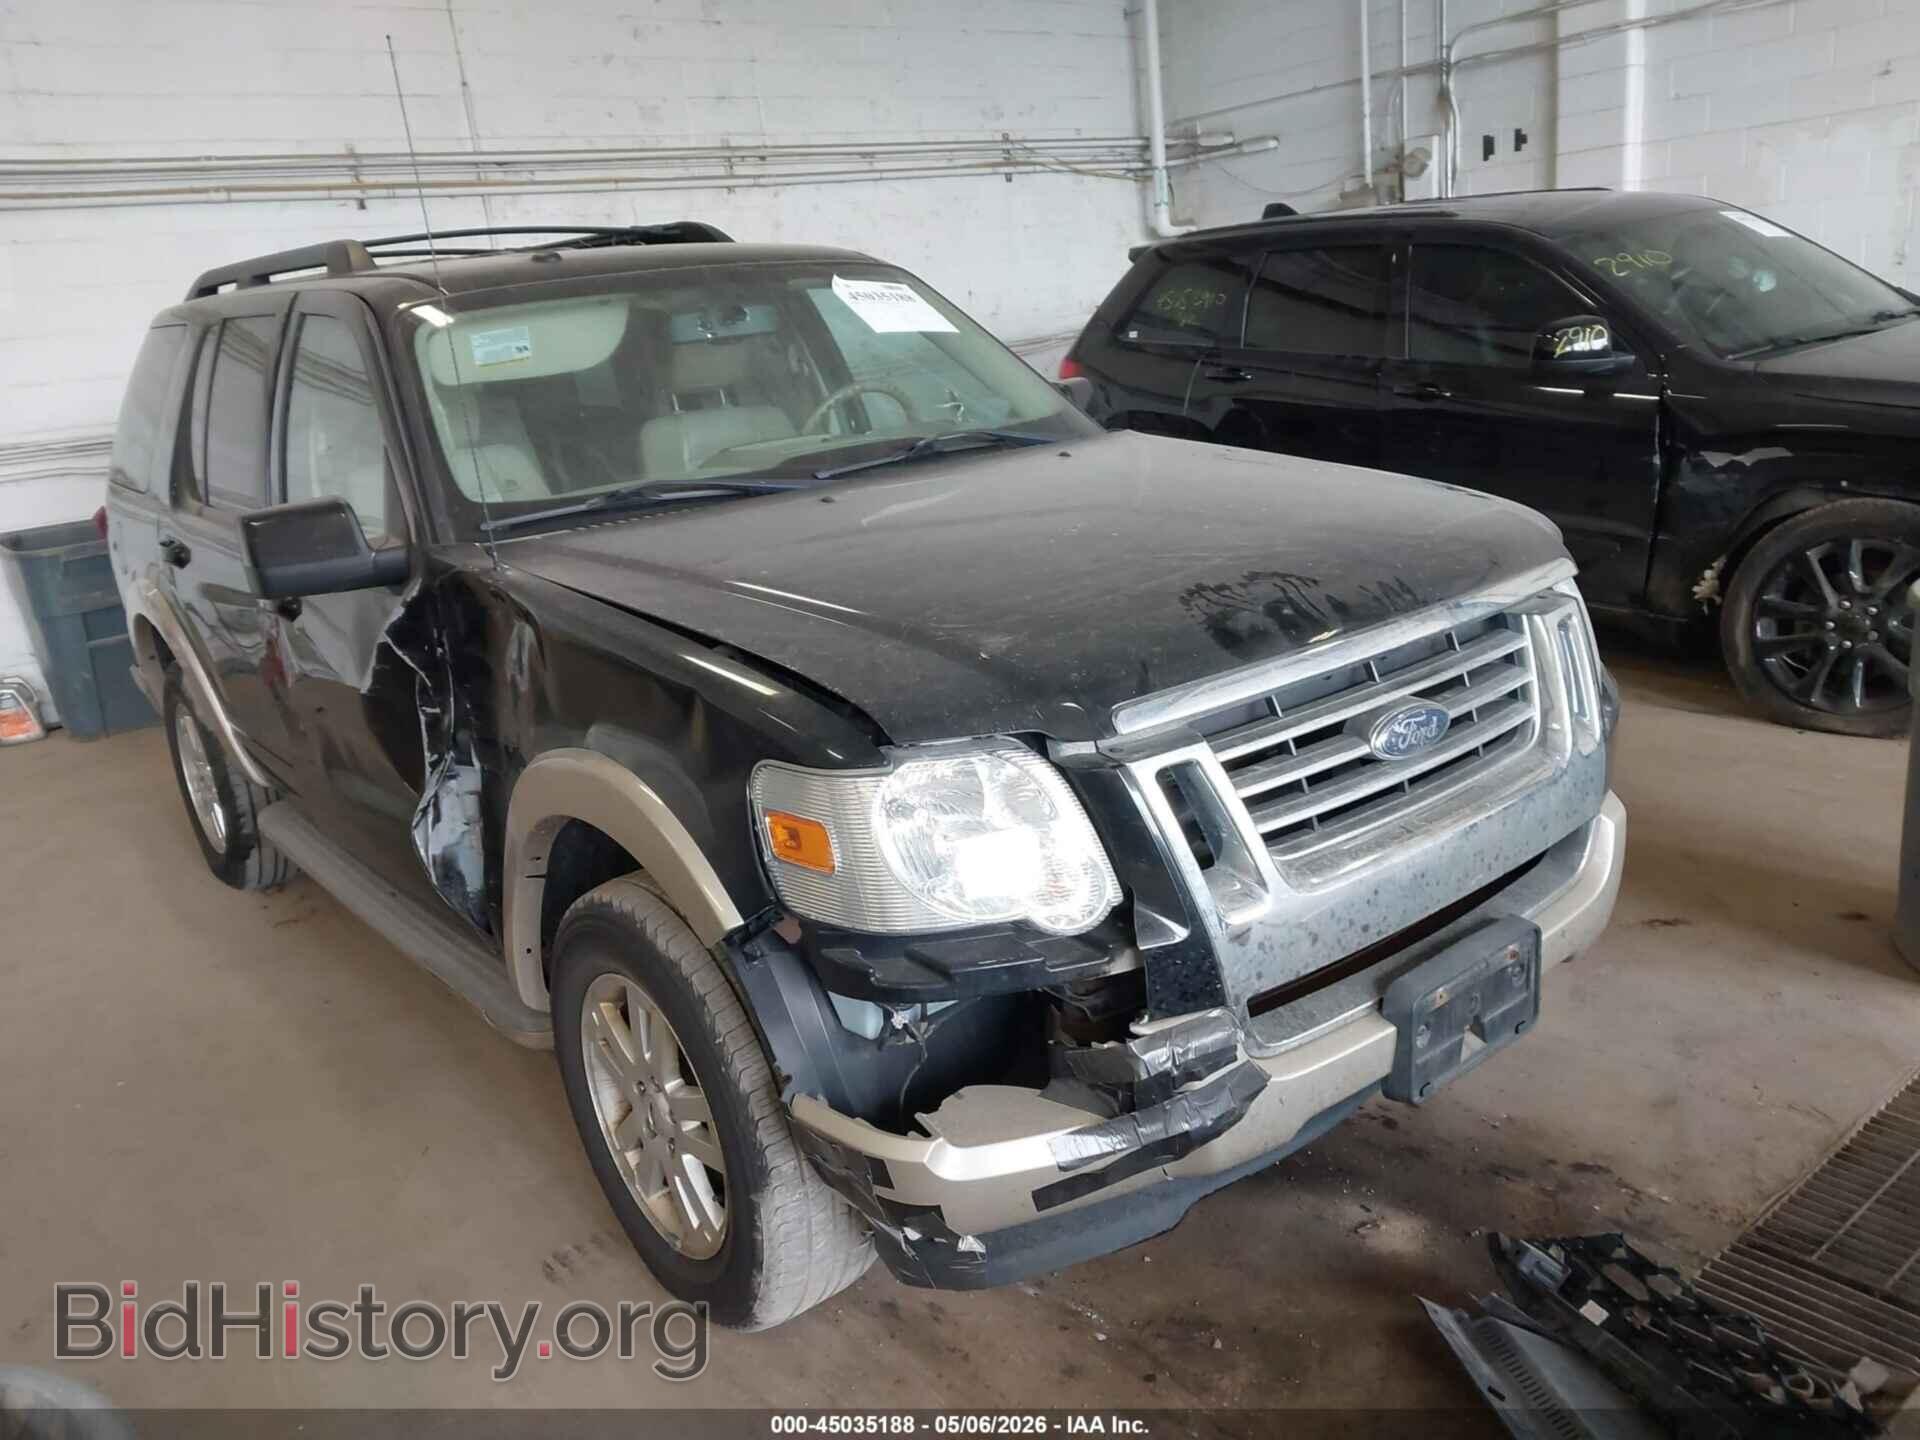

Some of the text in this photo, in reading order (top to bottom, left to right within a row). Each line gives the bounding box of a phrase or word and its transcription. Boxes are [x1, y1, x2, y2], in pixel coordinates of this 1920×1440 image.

[1593, 249, 1672, 277] 2910
[1553, 324, 1609, 358] 2910
[1391, 709, 1438, 752] Ford
